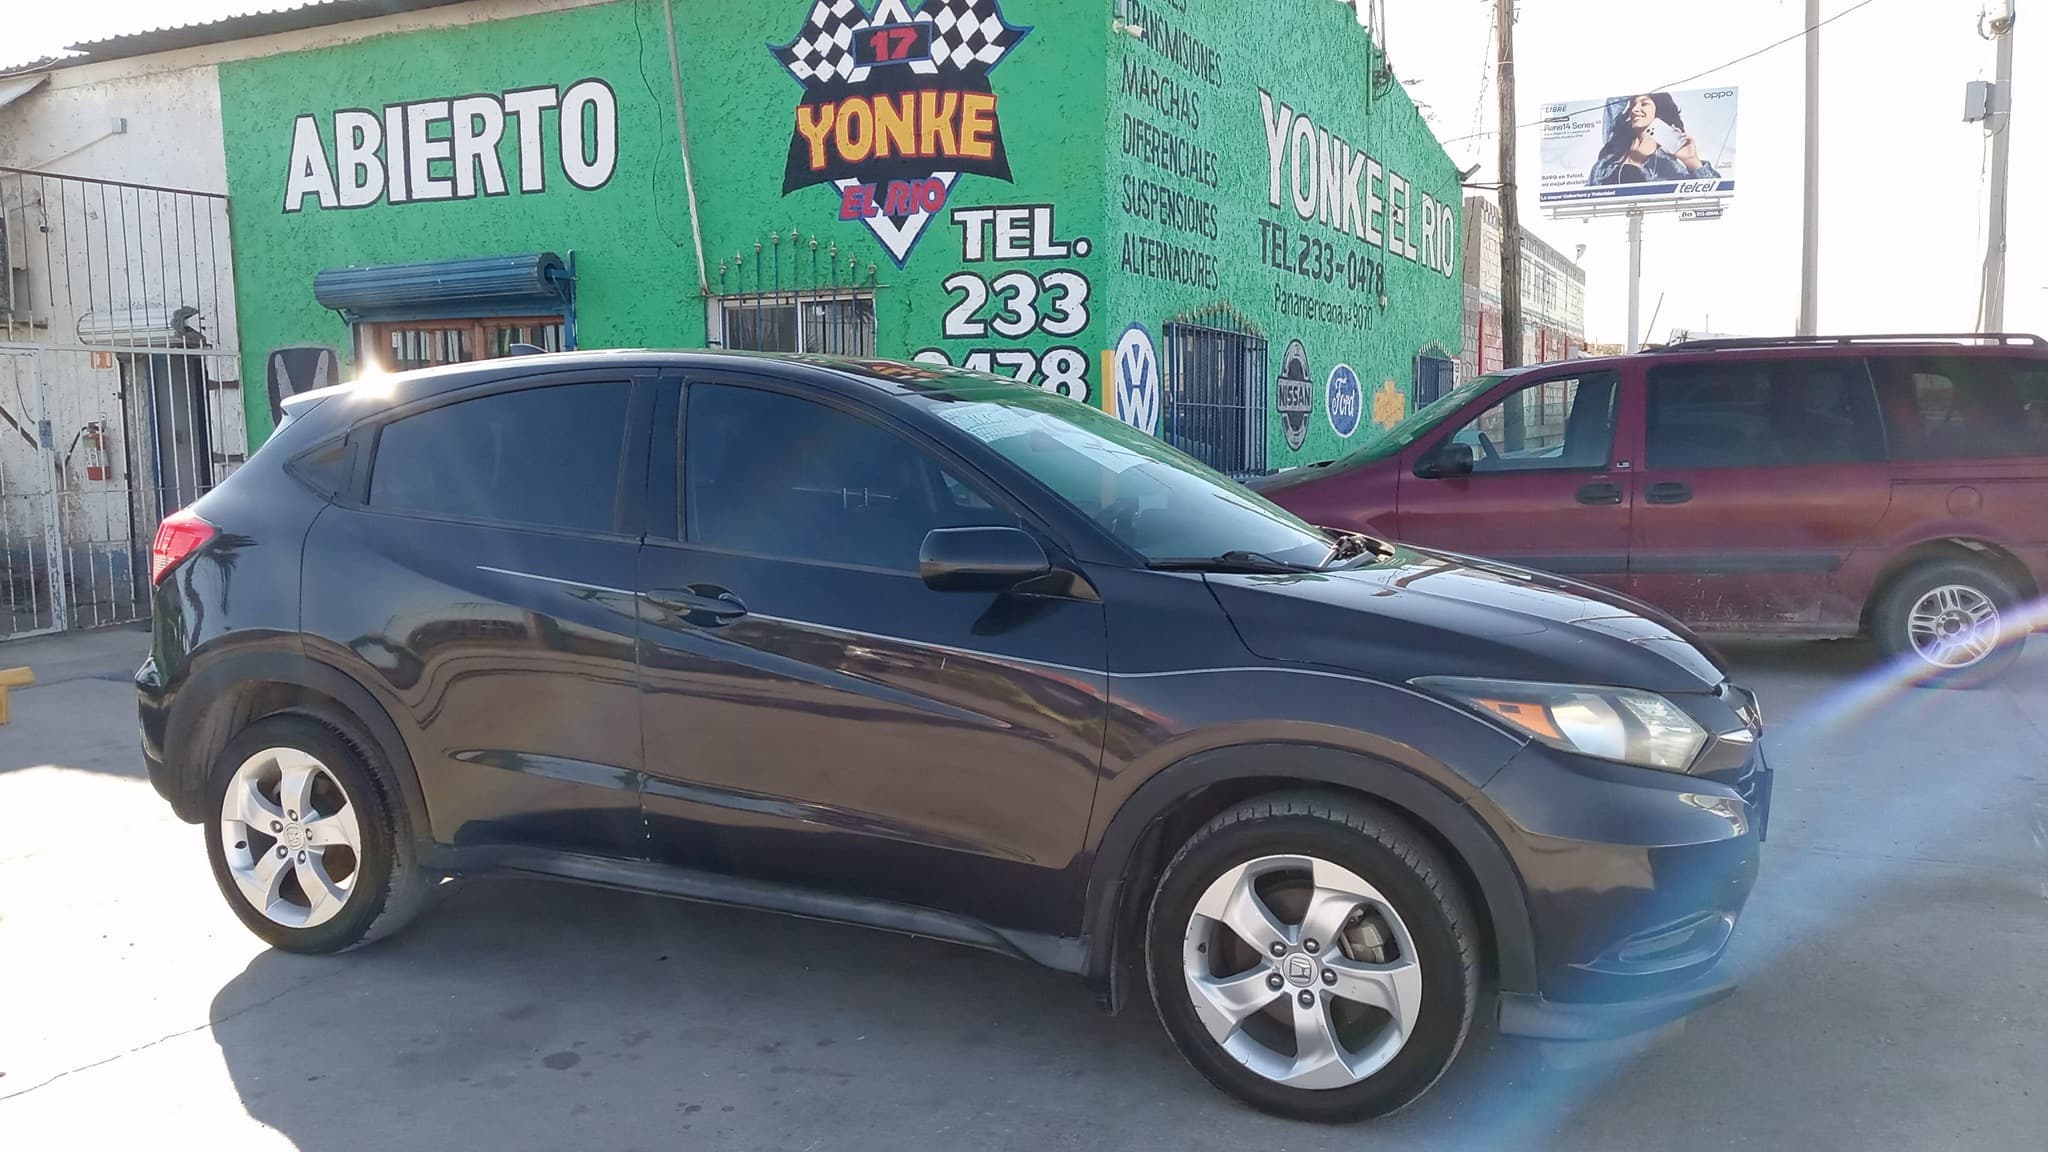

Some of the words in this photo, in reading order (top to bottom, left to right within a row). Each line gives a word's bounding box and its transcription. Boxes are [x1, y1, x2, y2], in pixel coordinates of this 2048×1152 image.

[869, 27, 918, 62] 17
[1121, 55, 1200, 130] MARCHAS
[282, 77, 618, 213] ABIERTO
[796, 90, 998, 171] YONKE
[1122, 113, 1218, 189] DIFERENCIALES
[839, 183, 879, 220] EL
[883, 177, 946, 216] RIO
[1122, 174, 1218, 241] SUSPENSIONES
[1258, 86, 1383, 249] YONKE
[1389, 169, 1417, 263] EL
[1421, 192, 1454, 279] RIO
[1679, 181, 1716, 193] telcel
[950, 204, 1092, 263] TEL.
[1121, 232, 1218, 291] ALTERNADORES
[941, 269, 1091, 340] 233
[1274, 283, 1343, 326] Panamericana
[913, 345, 1091, 404] 78
[1279, 383, 1312, 407] NISSAN
[1332, 377, 1356, 417] Ford
